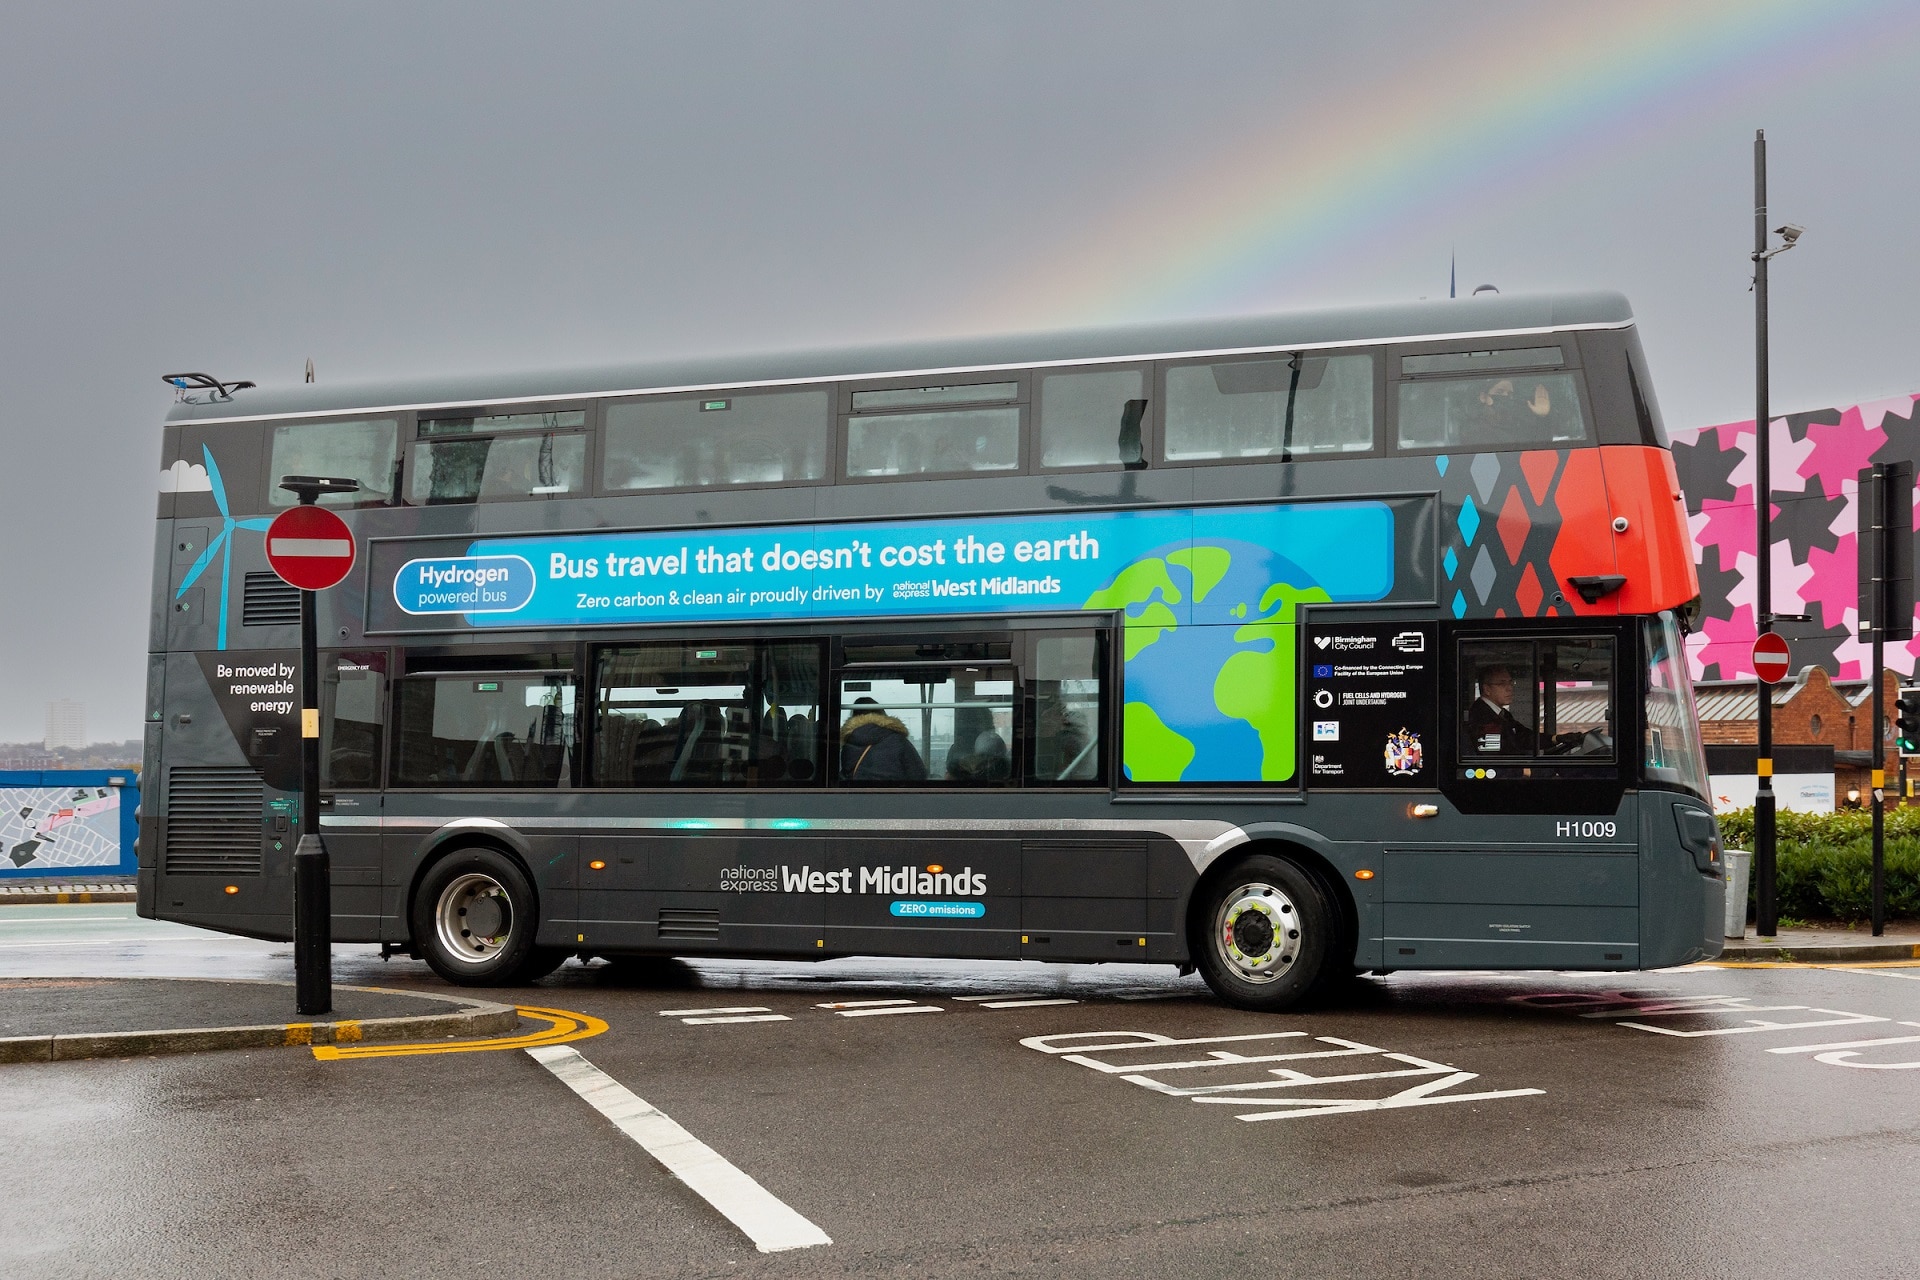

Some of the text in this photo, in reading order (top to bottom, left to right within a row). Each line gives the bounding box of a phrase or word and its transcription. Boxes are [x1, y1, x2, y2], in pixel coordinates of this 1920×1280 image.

[549, 530, 1099, 579] Bus travel that doesn’t cost the earth
[419, 565, 509, 588] Hydrogen
[892, 576, 1061, 597] national West Midlands
[418, 587, 507, 607] powered bus
[576, 584, 884, 608] Zero carbon & clean air proudly driven by
[892, 590, 930, 600] express
[1334, 635, 1377, 644] Birmingham
[1334, 642, 1375, 651] City Council
[217, 663, 295, 679] Be moved by
[230, 680, 295, 695] renewable
[1381, 691, 1407, 699] HYDROGEN
[250, 700, 294, 714] energy
[1556, 822, 1617, 838] H1009
[720, 864, 987, 895] national West Midlands
[720, 880, 778, 895] express
[899, 904, 976, 915] ZERO emissions
[1019, 1030, 1547, 1122] KEEP
